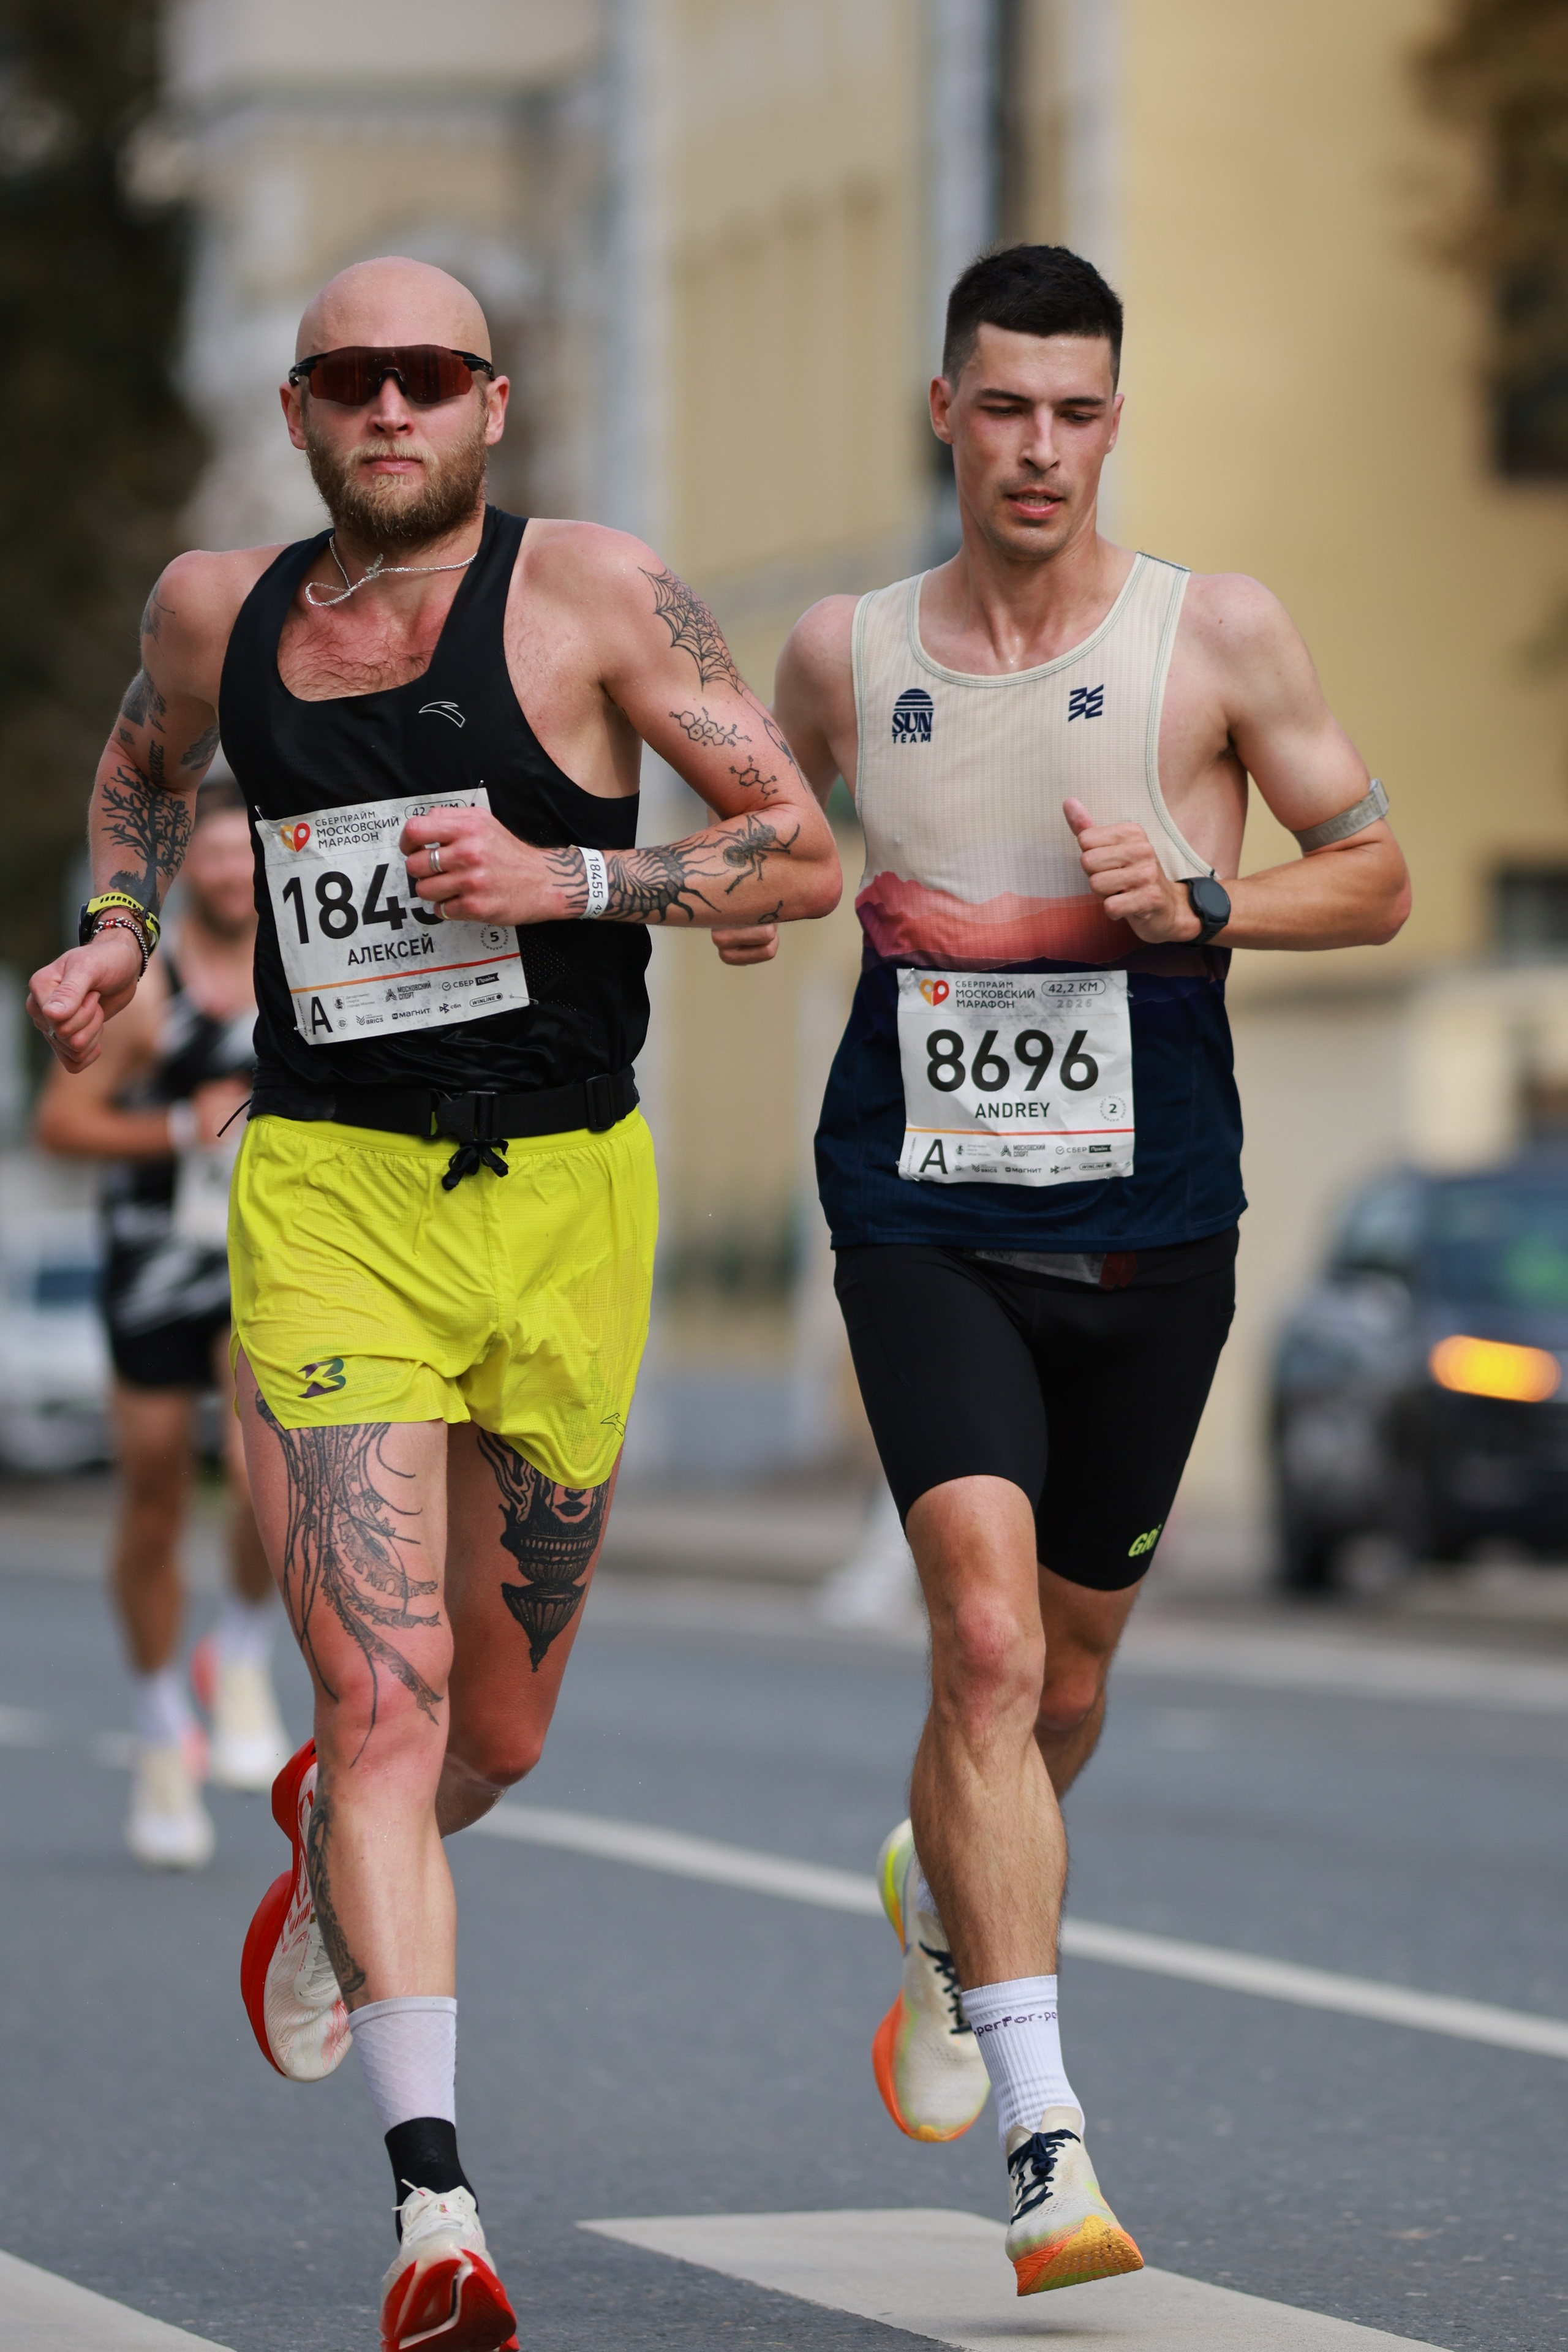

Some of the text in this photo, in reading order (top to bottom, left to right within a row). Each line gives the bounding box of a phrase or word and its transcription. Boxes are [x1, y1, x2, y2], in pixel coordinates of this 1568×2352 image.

[892, 712, 933, 733] SUN
[892, 733, 931, 744] TEAM
[315, 810, 376, 827] СБЕРПРАЙМ
[316, 815, 399, 838] МОСКОВСКИЙ
[318, 832, 379, 849] МАРАФОН
[589, 857, 603, 899] 18455
[490, 931, 499, 942] 5
[347, 933, 434, 966] АЛЕКСЕЙ
[453, 980, 474, 989] СБЕР
[956, 980, 1014, 989] СБЕРПРАЙМ
[1048, 983, 1074, 994] 42,2
[398, 992, 415, 1000] СПОРТ
[956, 989, 1035, 999] МОСКОВСКИЙ
[472, 995, 496, 1006] WINLINE
[956, 1000, 1015, 1009] МАРАФОН
[926, 1028, 1099, 1092] 8696
[974, 1102, 1050, 1118] ANDREY
[1109, 1103, 1117, 1114] 2
